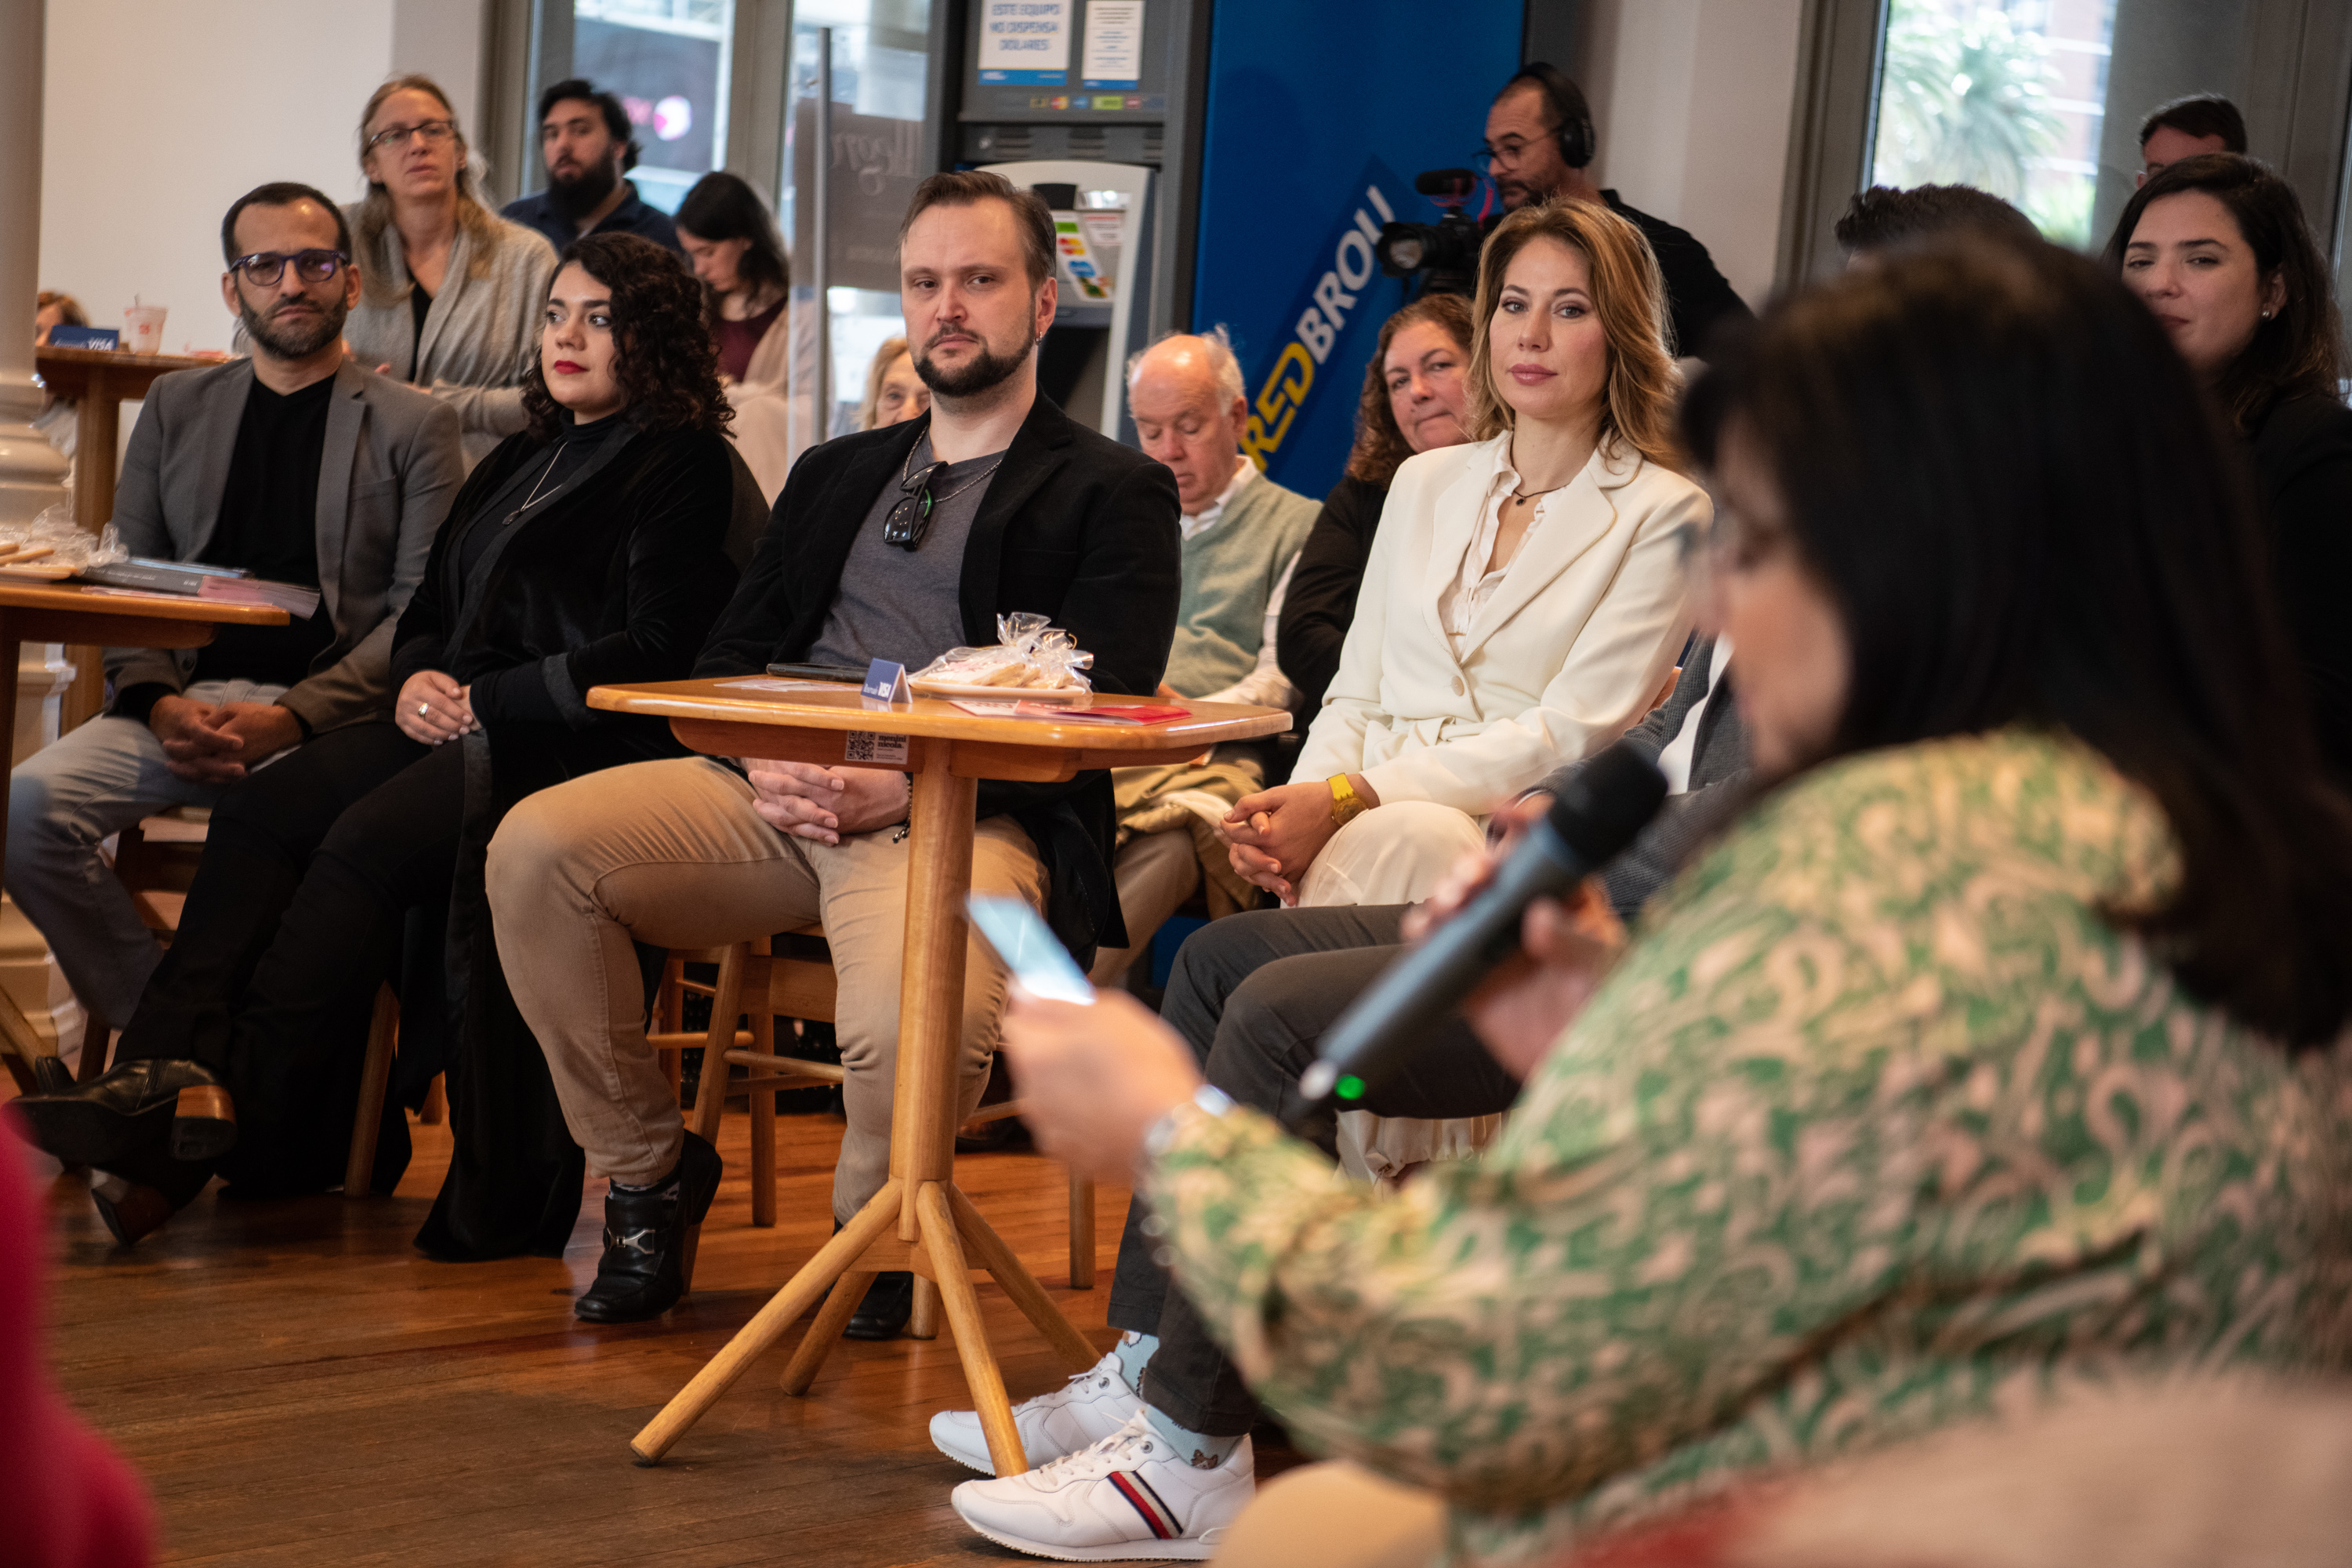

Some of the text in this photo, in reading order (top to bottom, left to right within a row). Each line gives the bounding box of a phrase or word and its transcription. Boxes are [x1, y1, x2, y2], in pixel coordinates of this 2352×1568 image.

[992, 4, 1060, 16] ESTE EQUIPO
[990, 21, 1058, 33] NO DISPENSA
[88, 337, 116, 351] VISA
[878, 681, 892, 698] VISA
